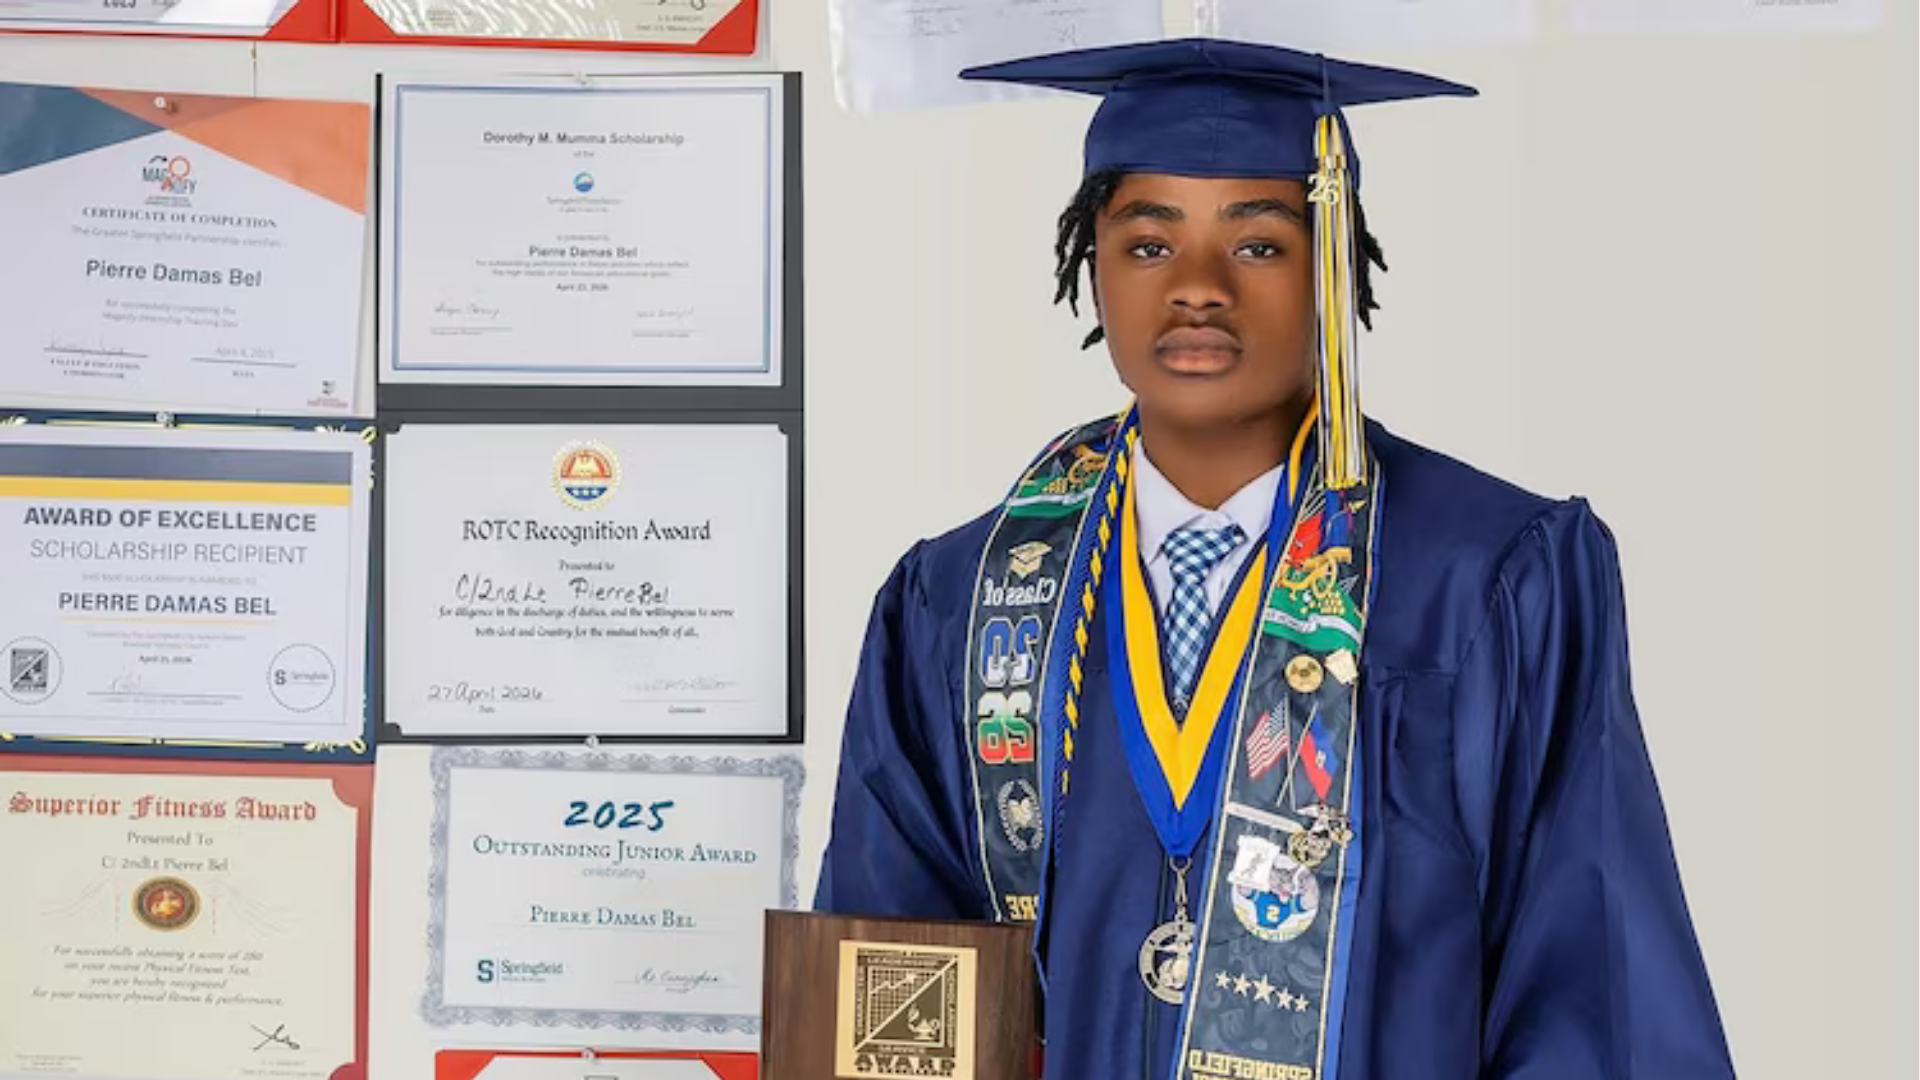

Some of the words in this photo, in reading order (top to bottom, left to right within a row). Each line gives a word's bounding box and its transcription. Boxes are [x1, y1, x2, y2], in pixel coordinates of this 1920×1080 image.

[483, 131, 535, 147] Dorothy
[537, 132, 553, 145] M.
[556, 132, 606, 145] Mumma
[609, 132, 685, 147] Scholarship
[1307, 173, 1340, 205] 26
[82, 205, 166, 222] CERTIFICATE
[170, 211, 186, 223] OF
[190, 212, 278, 229] COMPLETION
[72, 224, 90, 235] The
[130, 228, 183, 242] Springfield
[184, 231, 241, 246] Partnership
[528, 244, 566, 258] Pierre
[569, 245, 613, 258] Damas
[616, 246, 638, 258] Bel
[86, 260, 147, 280] Pierre
[153, 263, 222, 286] Damas
[229, 268, 263, 288] Bel
[555, 282, 575, 292] April
[23, 507, 113, 528] AWARD
[119, 508, 152, 528] OF
[157, 510, 317, 532] EXCELLENCE
[462, 519, 522, 541] ROTC
[525, 520, 638, 546] Recognition
[643, 519, 711, 541] Award
[30, 538, 188, 562] SCHOLARSHIP
[194, 542, 308, 564] RECIPIENT
[559, 558, 604, 571] Presented
[605, 560, 615, 571] to
[568, 576, 638, 601] Pierre
[638, 581, 670, 605] Bel
[58, 592, 140, 612] PIERRE
[145, 594, 227, 614] DAMAS
[234, 596, 278, 616] BEL
[455, 606, 494, 620] diligence
[507, 606, 520, 617] the
[523, 606, 562, 620] discharge
[610, 607, 627, 618] and
[628, 607, 643, 618] the
[645, 607, 697, 620] willingness
[710, 609, 735, 618] serve
[475, 625, 496, 638] both
[518, 627, 535, 638] and
[590, 626, 604, 638] the
[639, 626, 670, 640] benefit
[138, 654, 159, 665] April
[274, 669, 287, 686] S
[501, 685, 544, 701] 2026
[8, 791, 122, 818] Superior
[128, 793, 226, 821] Fitness
[234, 796, 318, 822] Award
[563, 800, 675, 832] 2025
[127, 830, 192, 846] Presented
[197, 833, 214, 847] To
[472, 834, 612, 860] OUTSTANDING
[614, 839, 686, 865] JUNIOR
[688, 842, 758, 865] AWARD
[163, 857, 204, 872] Pierre
[208, 857, 229, 872] Bel
[580, 865, 647, 880] celebrating
[529, 905, 592, 925] PIERRE
[597, 907, 657, 928] DAMAS
[661, 909, 697, 928] BEL
[53, 945, 72, 956] For
[74, 946, 134, 958] successfully
[136, 948, 185, 961] obtaining
[197, 951, 225, 961] score
[227, 950, 240, 961] of
[80, 962, 106, 972] your
[107, 962, 141, 971] recent
[143, 961, 187, 975] Physical
[188, 963, 224, 975] Fitness
[477, 959, 495, 984] S
[501, 959, 564, 977] Springfield
[89, 978, 110, 988] you
[111, 978, 130, 987] are
[132, 977, 167, 990] hereby
[169, 978, 229, 991] recognized
[50, 989, 76, 1000] your
[77, 989, 121, 1002] superior
[122, 988, 169, 1003] physical
[168, 990, 202, 1003] fitness
[855, 1053, 956, 1070] AWARD
